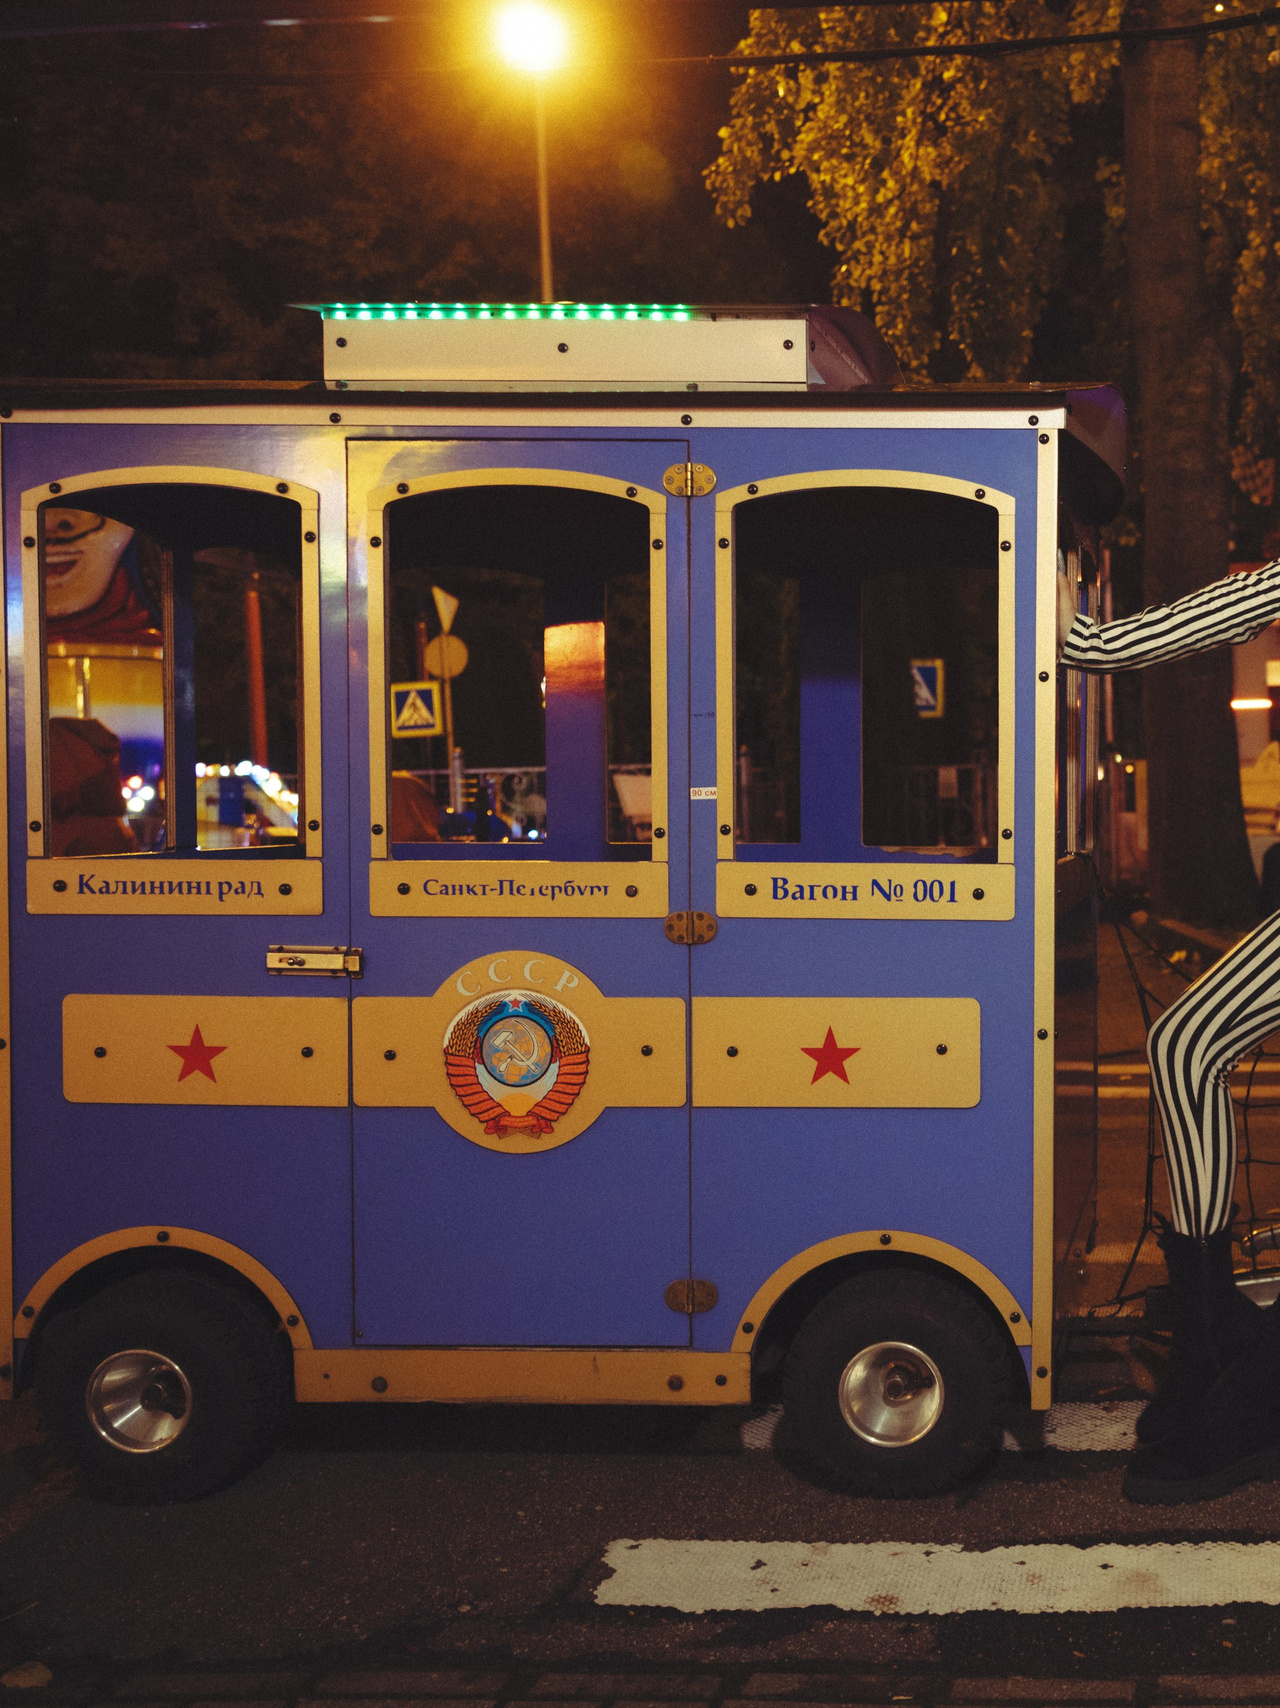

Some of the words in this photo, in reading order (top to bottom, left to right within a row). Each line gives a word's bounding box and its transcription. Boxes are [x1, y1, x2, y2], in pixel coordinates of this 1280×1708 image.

[691, 789, 702, 797] 90
[770, 876, 860, 901] Вагон
[870, 878, 904, 902] №
[912, 878, 959, 903] 001
[456, 958, 579, 997] СССР
